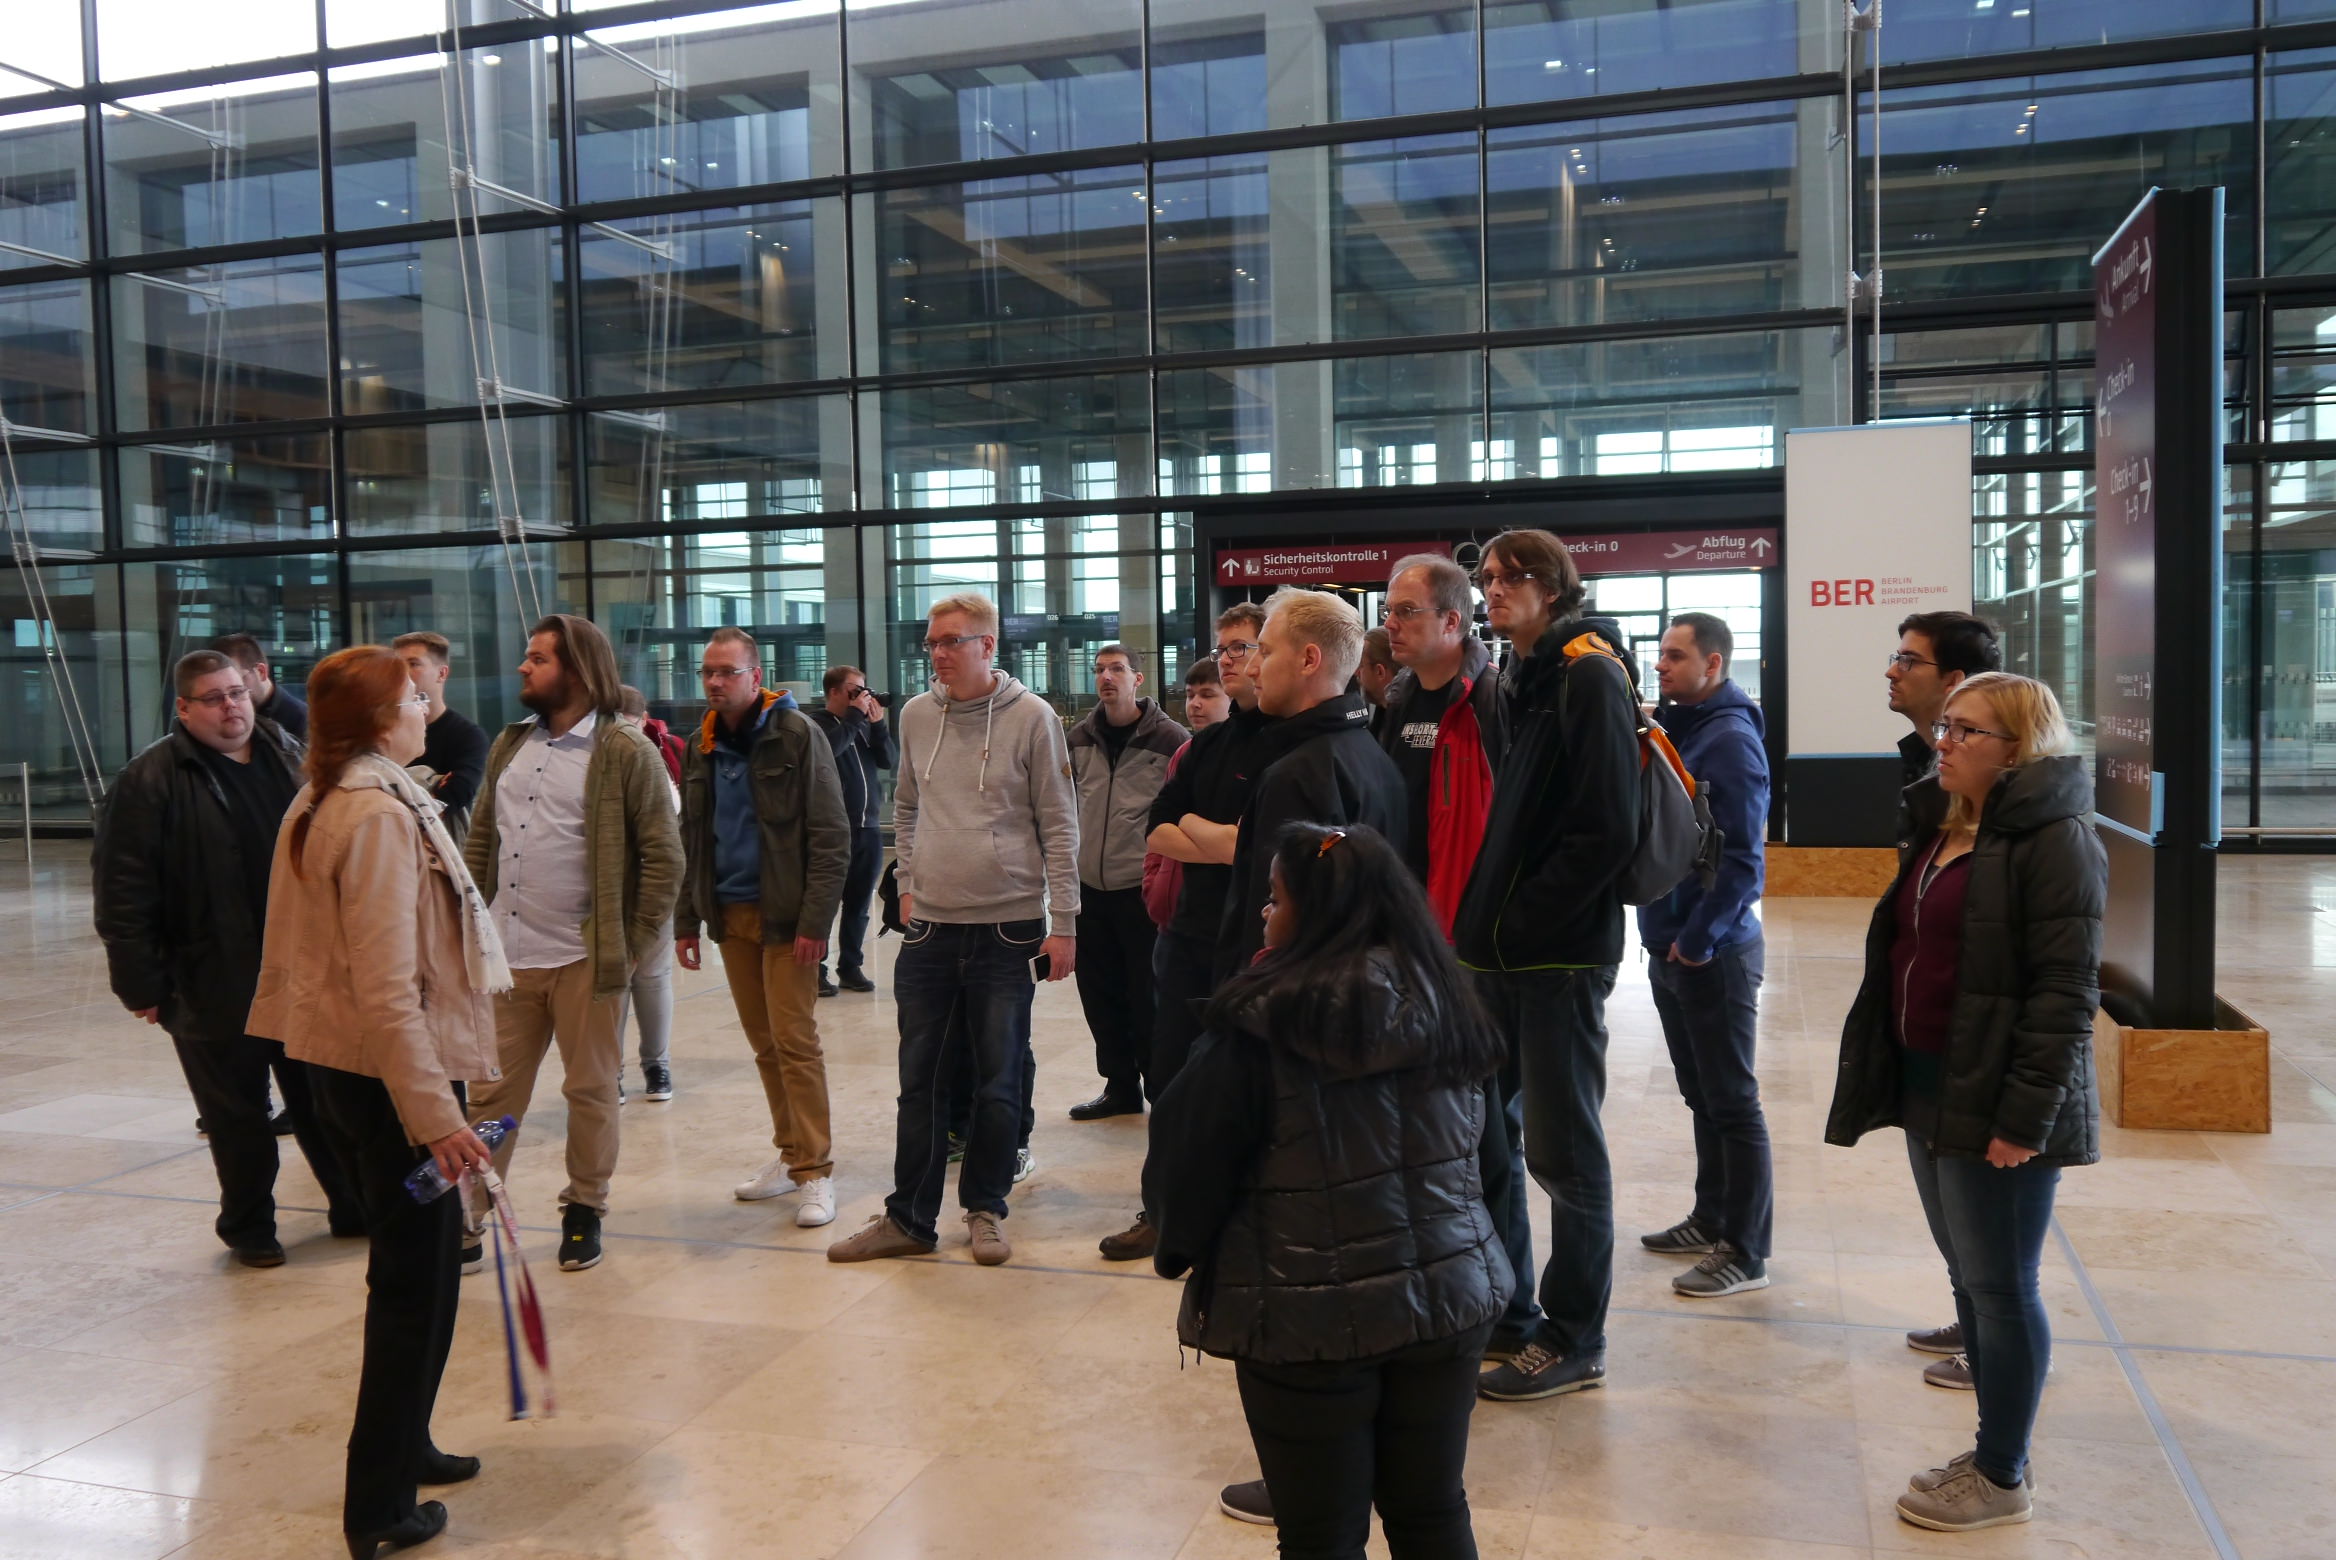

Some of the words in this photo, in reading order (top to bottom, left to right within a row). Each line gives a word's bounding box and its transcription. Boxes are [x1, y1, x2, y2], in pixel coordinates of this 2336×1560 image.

[2112, 240, 2139, 292] Ankunft
[2107, 358, 2135, 401] Check-in
[2111, 456, 2139, 495] Check-in
[1560, 541, 1607, 553] heck-in
[1702, 536, 1746, 550] Abflug
[1263, 550, 1379, 565] Sicherheitskontrolle
[1381, 550, 1388, 561] 1
[1697, 550, 1746, 561] Departure
[1264, 566, 1299, 577] Security
[1301, 565, 1334, 576] Control
[1881, 577, 1913, 585] BERLIN
[1811, 578, 1875, 607] BER
[1881, 586, 1949, 595] BRANDENBURG
[1881, 597, 1919, 605] AIRPORT
[1346, 709, 1363, 720] HELLY
